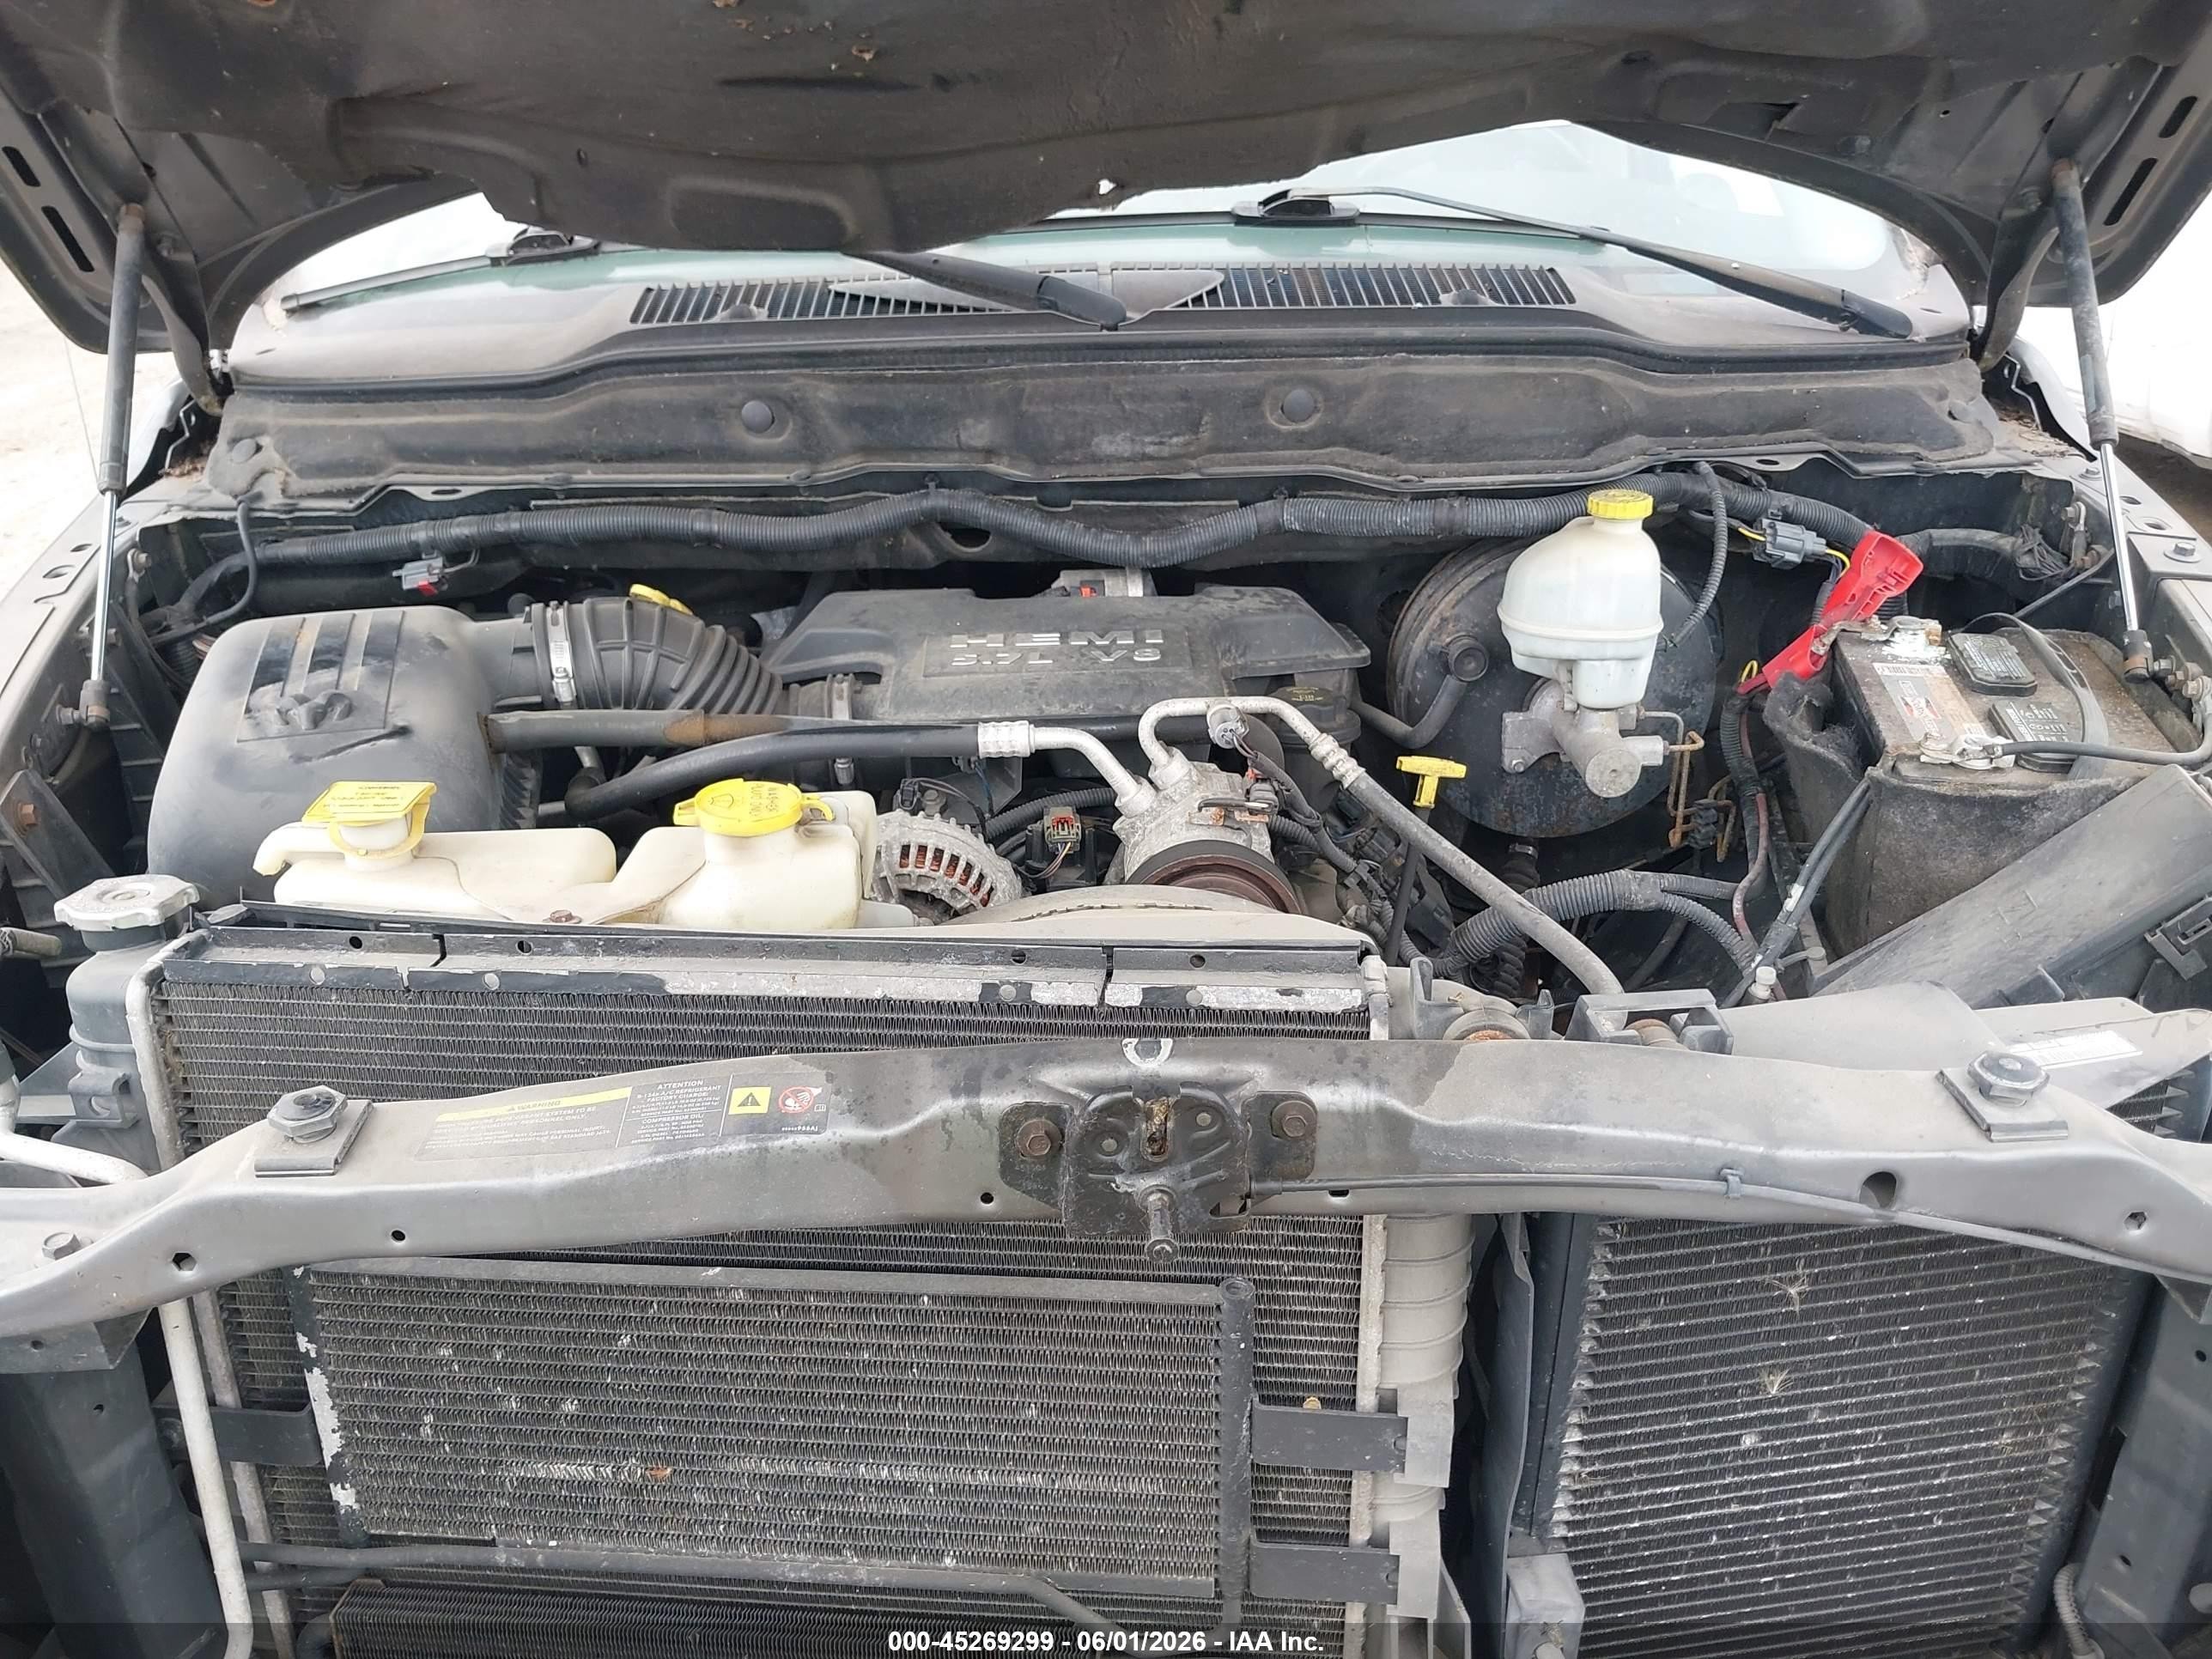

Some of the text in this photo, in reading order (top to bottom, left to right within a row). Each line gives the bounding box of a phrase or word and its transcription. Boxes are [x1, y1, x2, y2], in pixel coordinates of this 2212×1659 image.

[950, 629, 1164, 648] HEMI
[951, 647, 1161, 665] 5.7L V8
[657, 1079, 704, 1090] ATTENTION
[517, 1100, 562, 1111] WARNING
